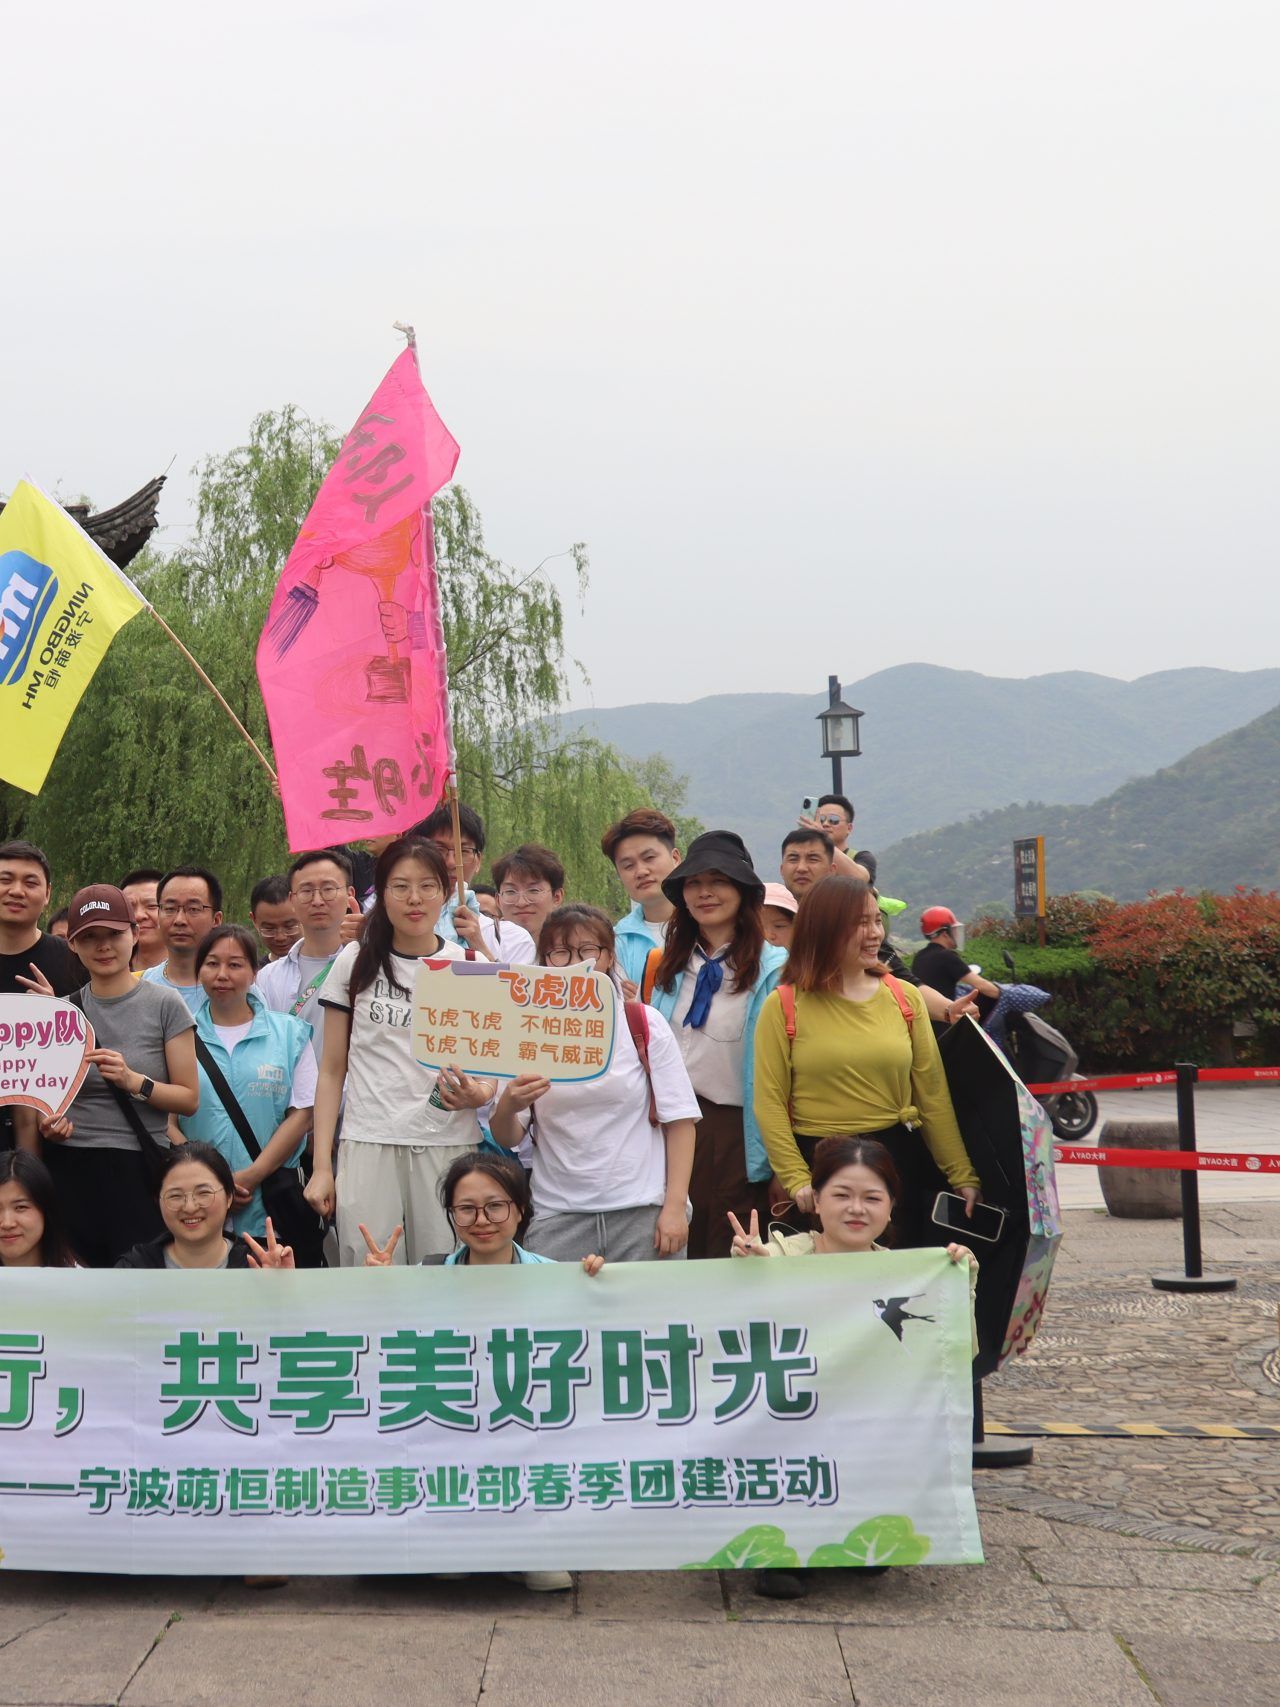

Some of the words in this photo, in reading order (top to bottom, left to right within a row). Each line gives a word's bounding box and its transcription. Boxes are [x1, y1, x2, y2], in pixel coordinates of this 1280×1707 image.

[79, 901, 110, 916] COLORADO
[498, 971, 603, 1011] 飞虎队
[419, 1006, 503, 1031] 飞虎飞虎
[520, 1014, 605, 1039] 不怕险阻
[417, 1033, 500, 1058] 飞虎飞虎
[518, 1041, 604, 1067] 霸气威武
[35, 1073, 69, 1090] day
